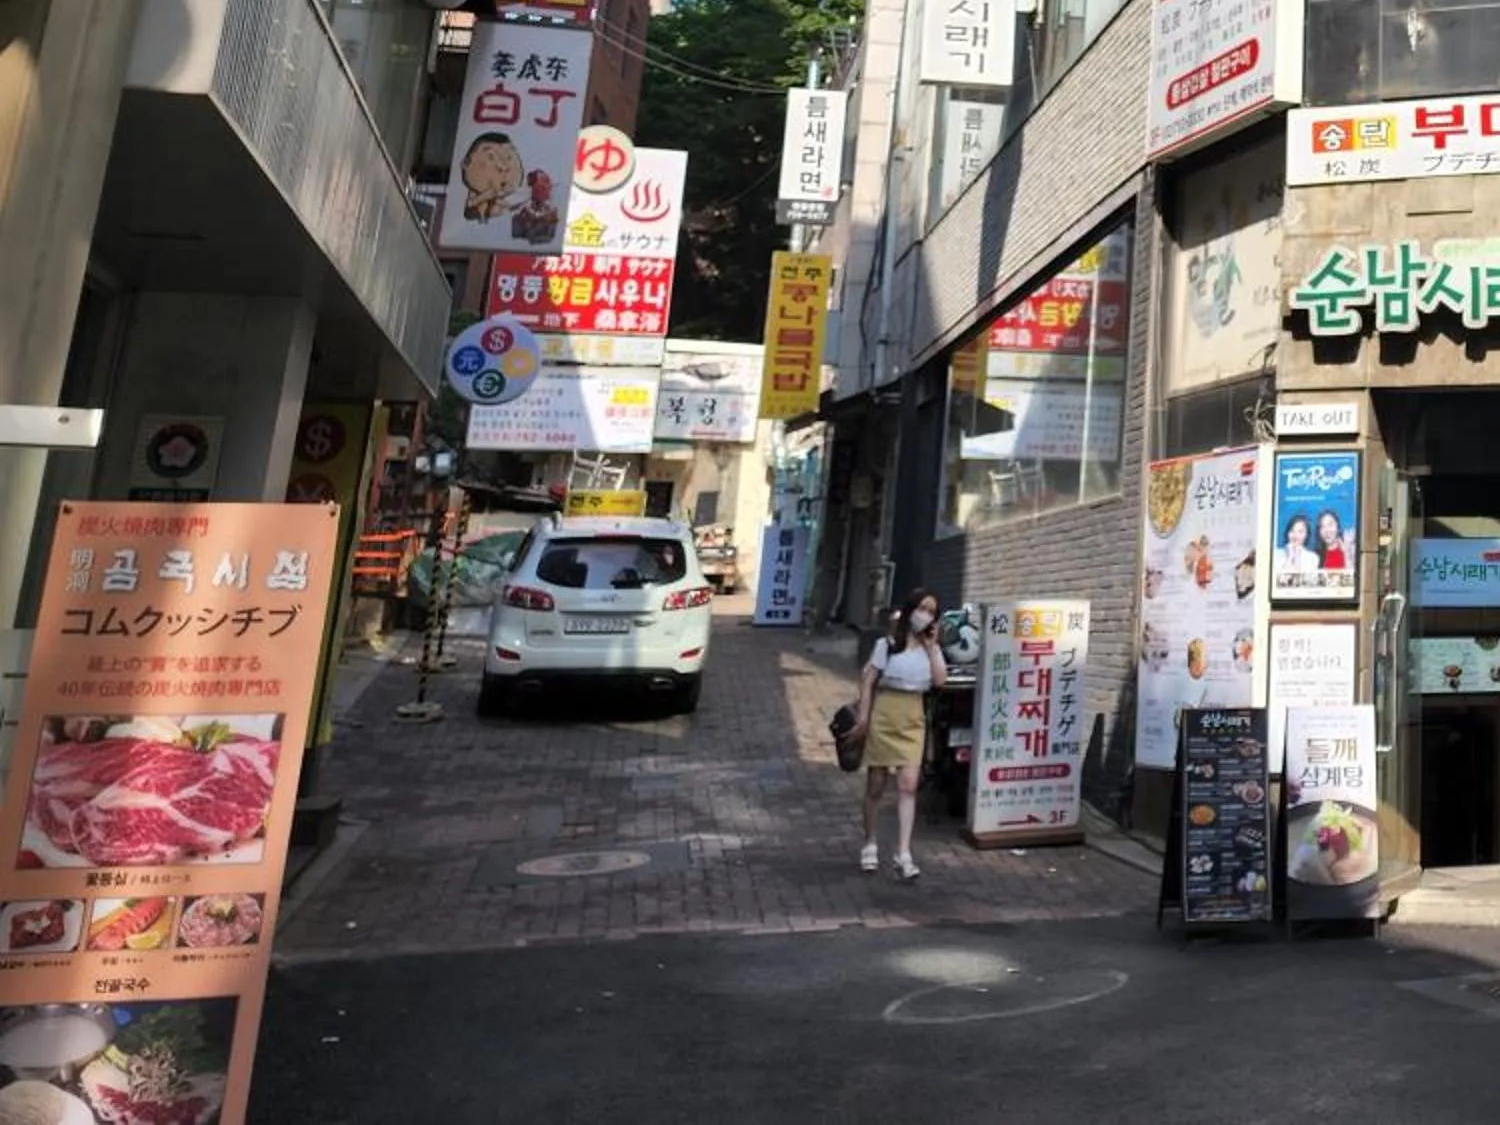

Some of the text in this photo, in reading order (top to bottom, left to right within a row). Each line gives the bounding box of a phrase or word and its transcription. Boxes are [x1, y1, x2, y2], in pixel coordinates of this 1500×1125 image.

[472, 83, 577, 129] 白丁
[800, 95, 831, 194] 틈새라면
[1322, 158, 1381, 178] 松炭
[1281, 410, 1353, 427] TAKE OUT
[60, 604, 303, 639] コムクッシチブ
[1014, 639, 1057, 759] 부대찌개
[1304, 736, 1359, 765] 들깨
